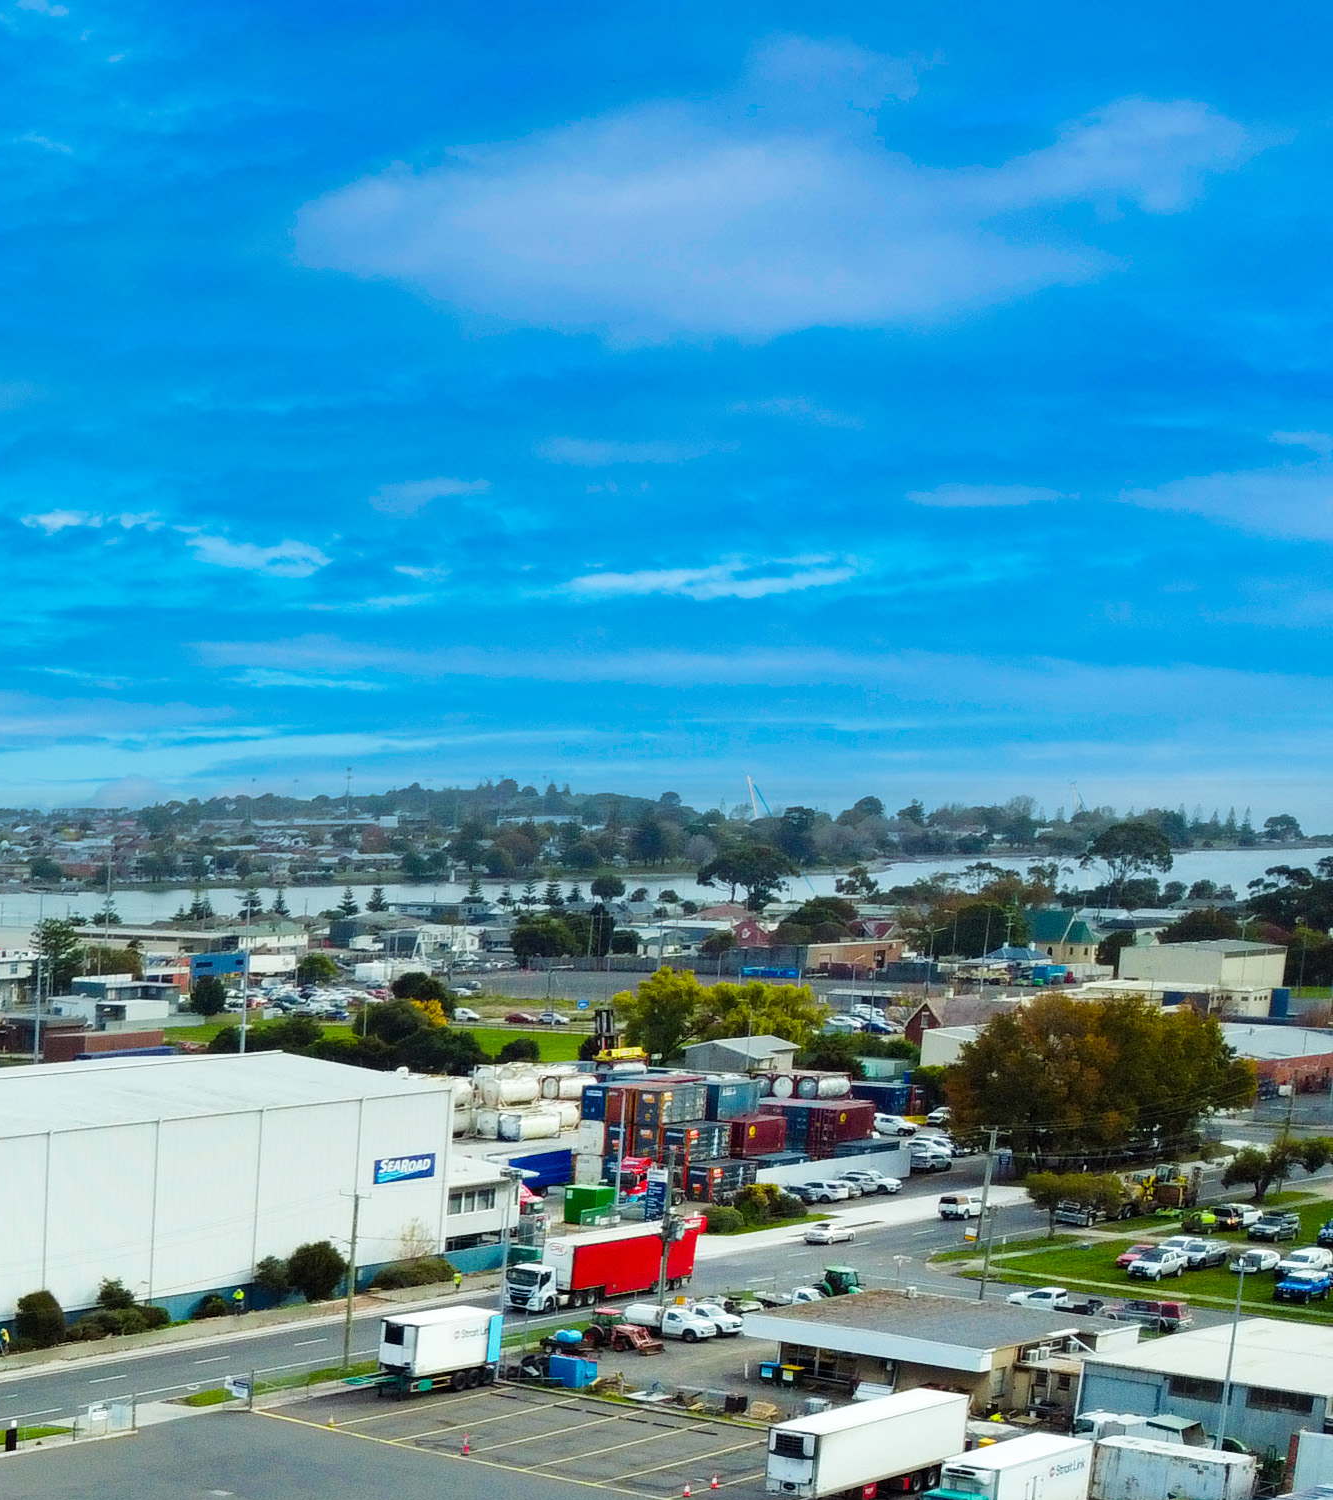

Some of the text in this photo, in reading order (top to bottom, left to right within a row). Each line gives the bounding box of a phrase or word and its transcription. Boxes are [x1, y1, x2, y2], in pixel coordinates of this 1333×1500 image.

[378, 1158, 432, 1173] SEAROAD
[1055, 1457, 1087, 1477] Strait Link
